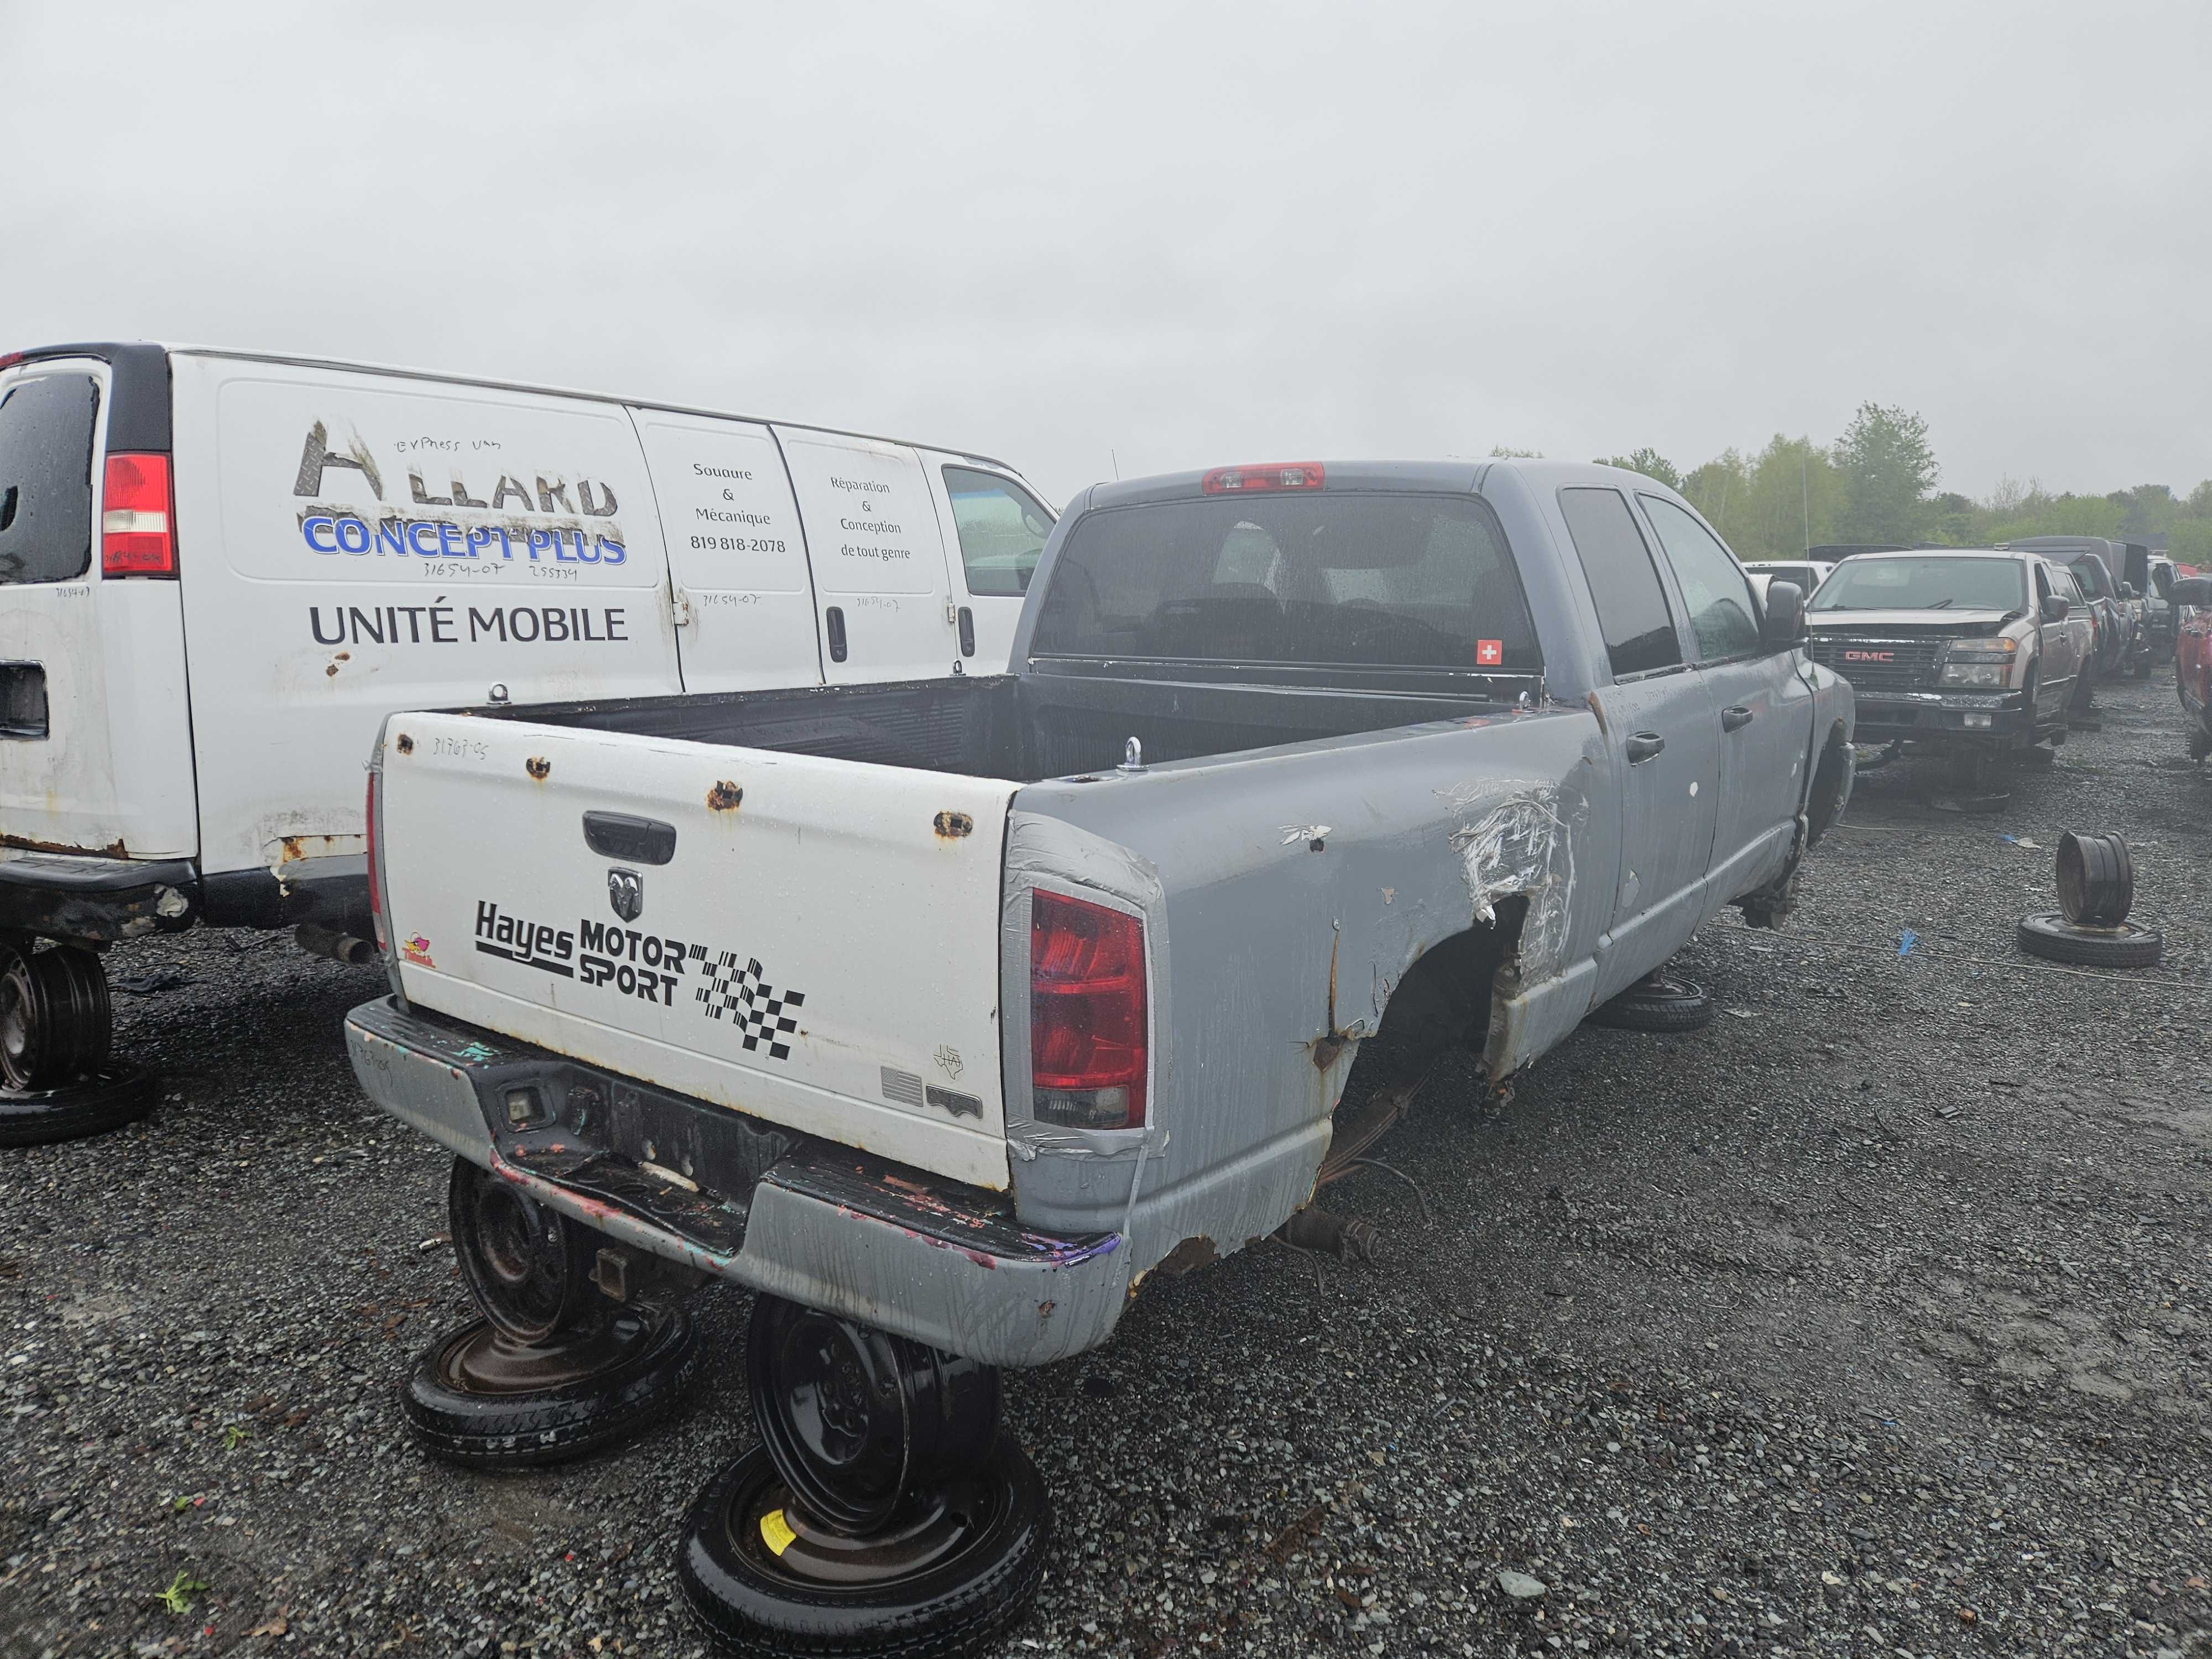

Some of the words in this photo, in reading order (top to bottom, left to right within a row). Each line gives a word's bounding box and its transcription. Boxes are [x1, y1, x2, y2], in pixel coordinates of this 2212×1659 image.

[830, 477, 890, 493] Réparation
[723, 488, 735, 501] &
[862, 500, 872, 512] &
[696, 508, 771, 526] Mécanique
[841, 518, 901, 535] Conception
[301, 515, 515, 560] CONCEPT
[525, 528, 627, 565] PLUS
[691, 536, 717, 549] 819
[720, 538, 786, 552] 818-2078
[841, 544, 854, 556] de
[857, 546, 879, 557] tout
[881, 549, 911, 561] genre
[310, 596, 458, 644] UNITÉ
[468, 607, 629, 642] MOBILE
[1845, 651, 1894, 662] GMC
[476, 900, 574, 962] Hayes
[580, 919, 686, 974] MOTOR
[580, 953, 678, 1007] SPORT
